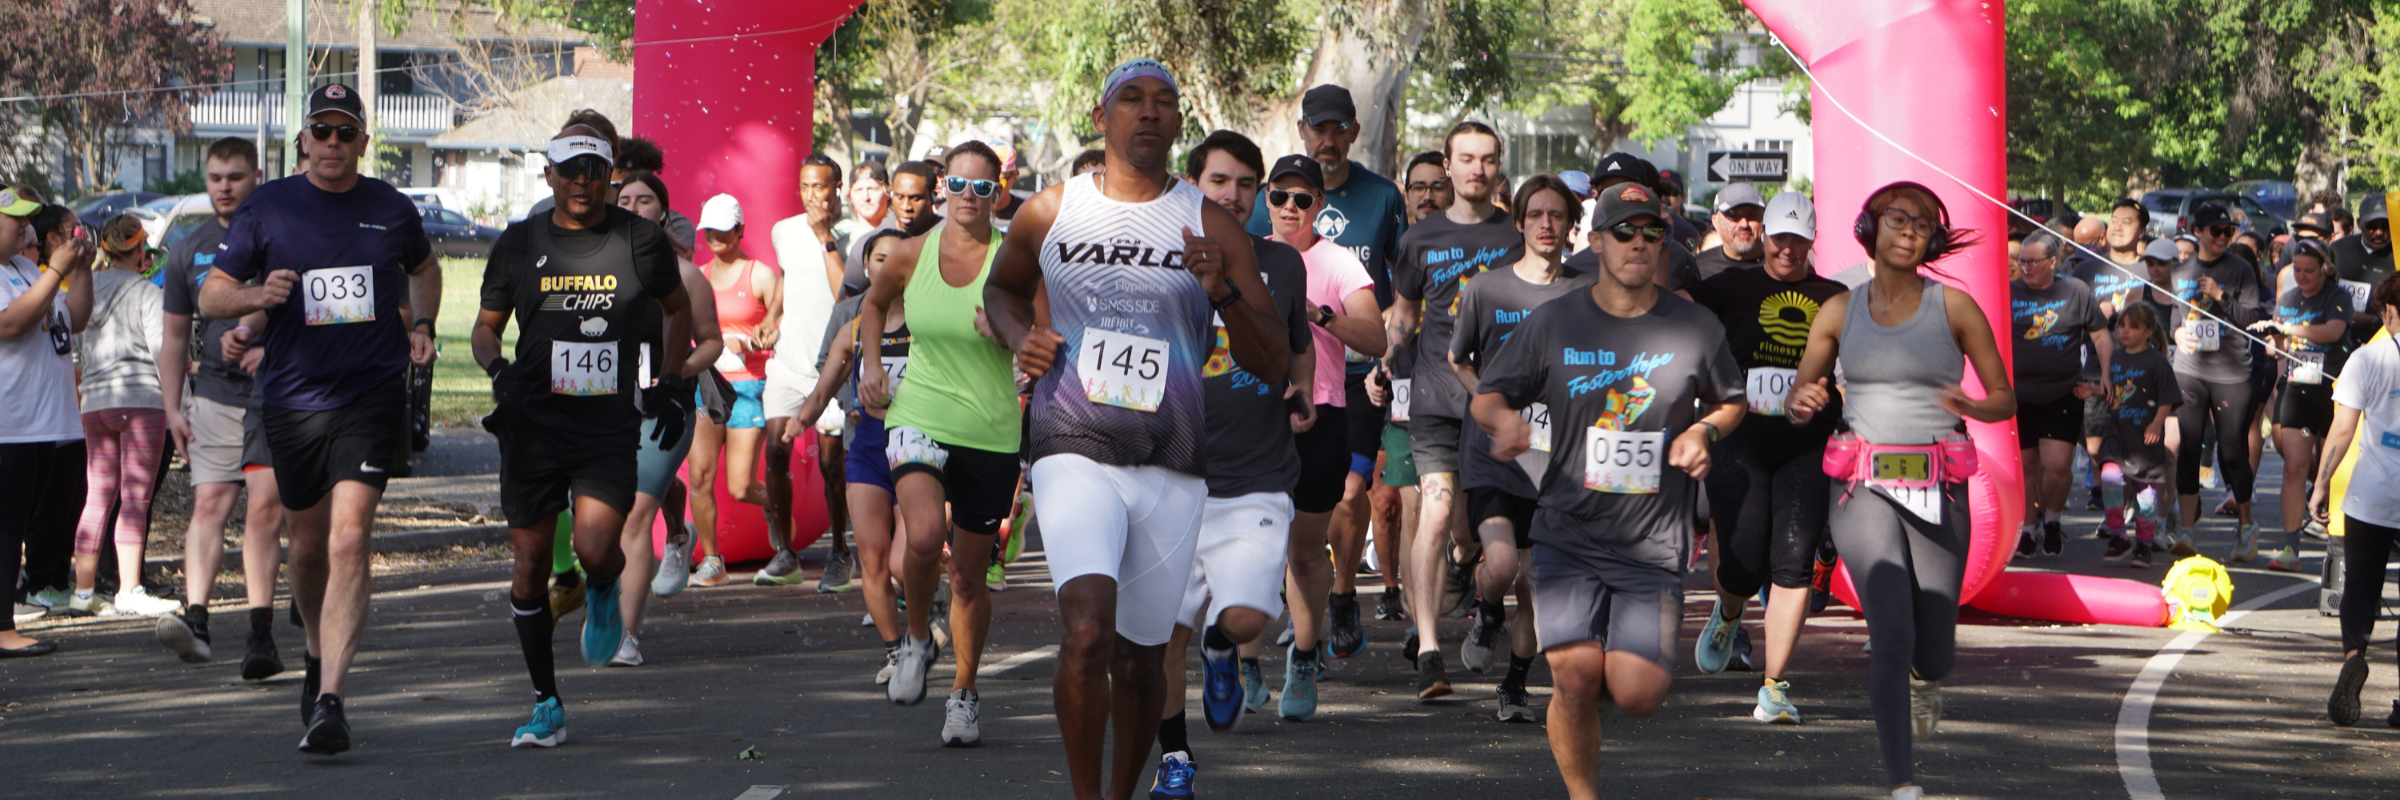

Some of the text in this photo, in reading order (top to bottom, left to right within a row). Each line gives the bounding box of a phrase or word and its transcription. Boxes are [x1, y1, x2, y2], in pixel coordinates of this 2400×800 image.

[1729, 161, 1780, 174] ONE WAY
[1109, 238, 1141, 246] TEAM
[1348, 245, 1370, 260] NG
[1427, 247, 1465, 265] Run to
[310, 273, 367, 301] 033
[540, 275, 617, 292] BUFFALO
[1115, 280, 1167, 294] Hyperice
[2344, 284, 2366, 300] 99
[562, 293, 615, 311] CHIPS
[1099, 299, 1160, 314] SWISS SIDE
[1495, 309, 1521, 324] Run
[1563, 347, 1616, 366] Run to
[1759, 341, 1797, 357] Fitness
[560, 348, 613, 374] 146
[1092, 339, 1161, 381] 145
[1593, 437, 1655, 468] 055
[1894, 484, 1929, 508] 91
